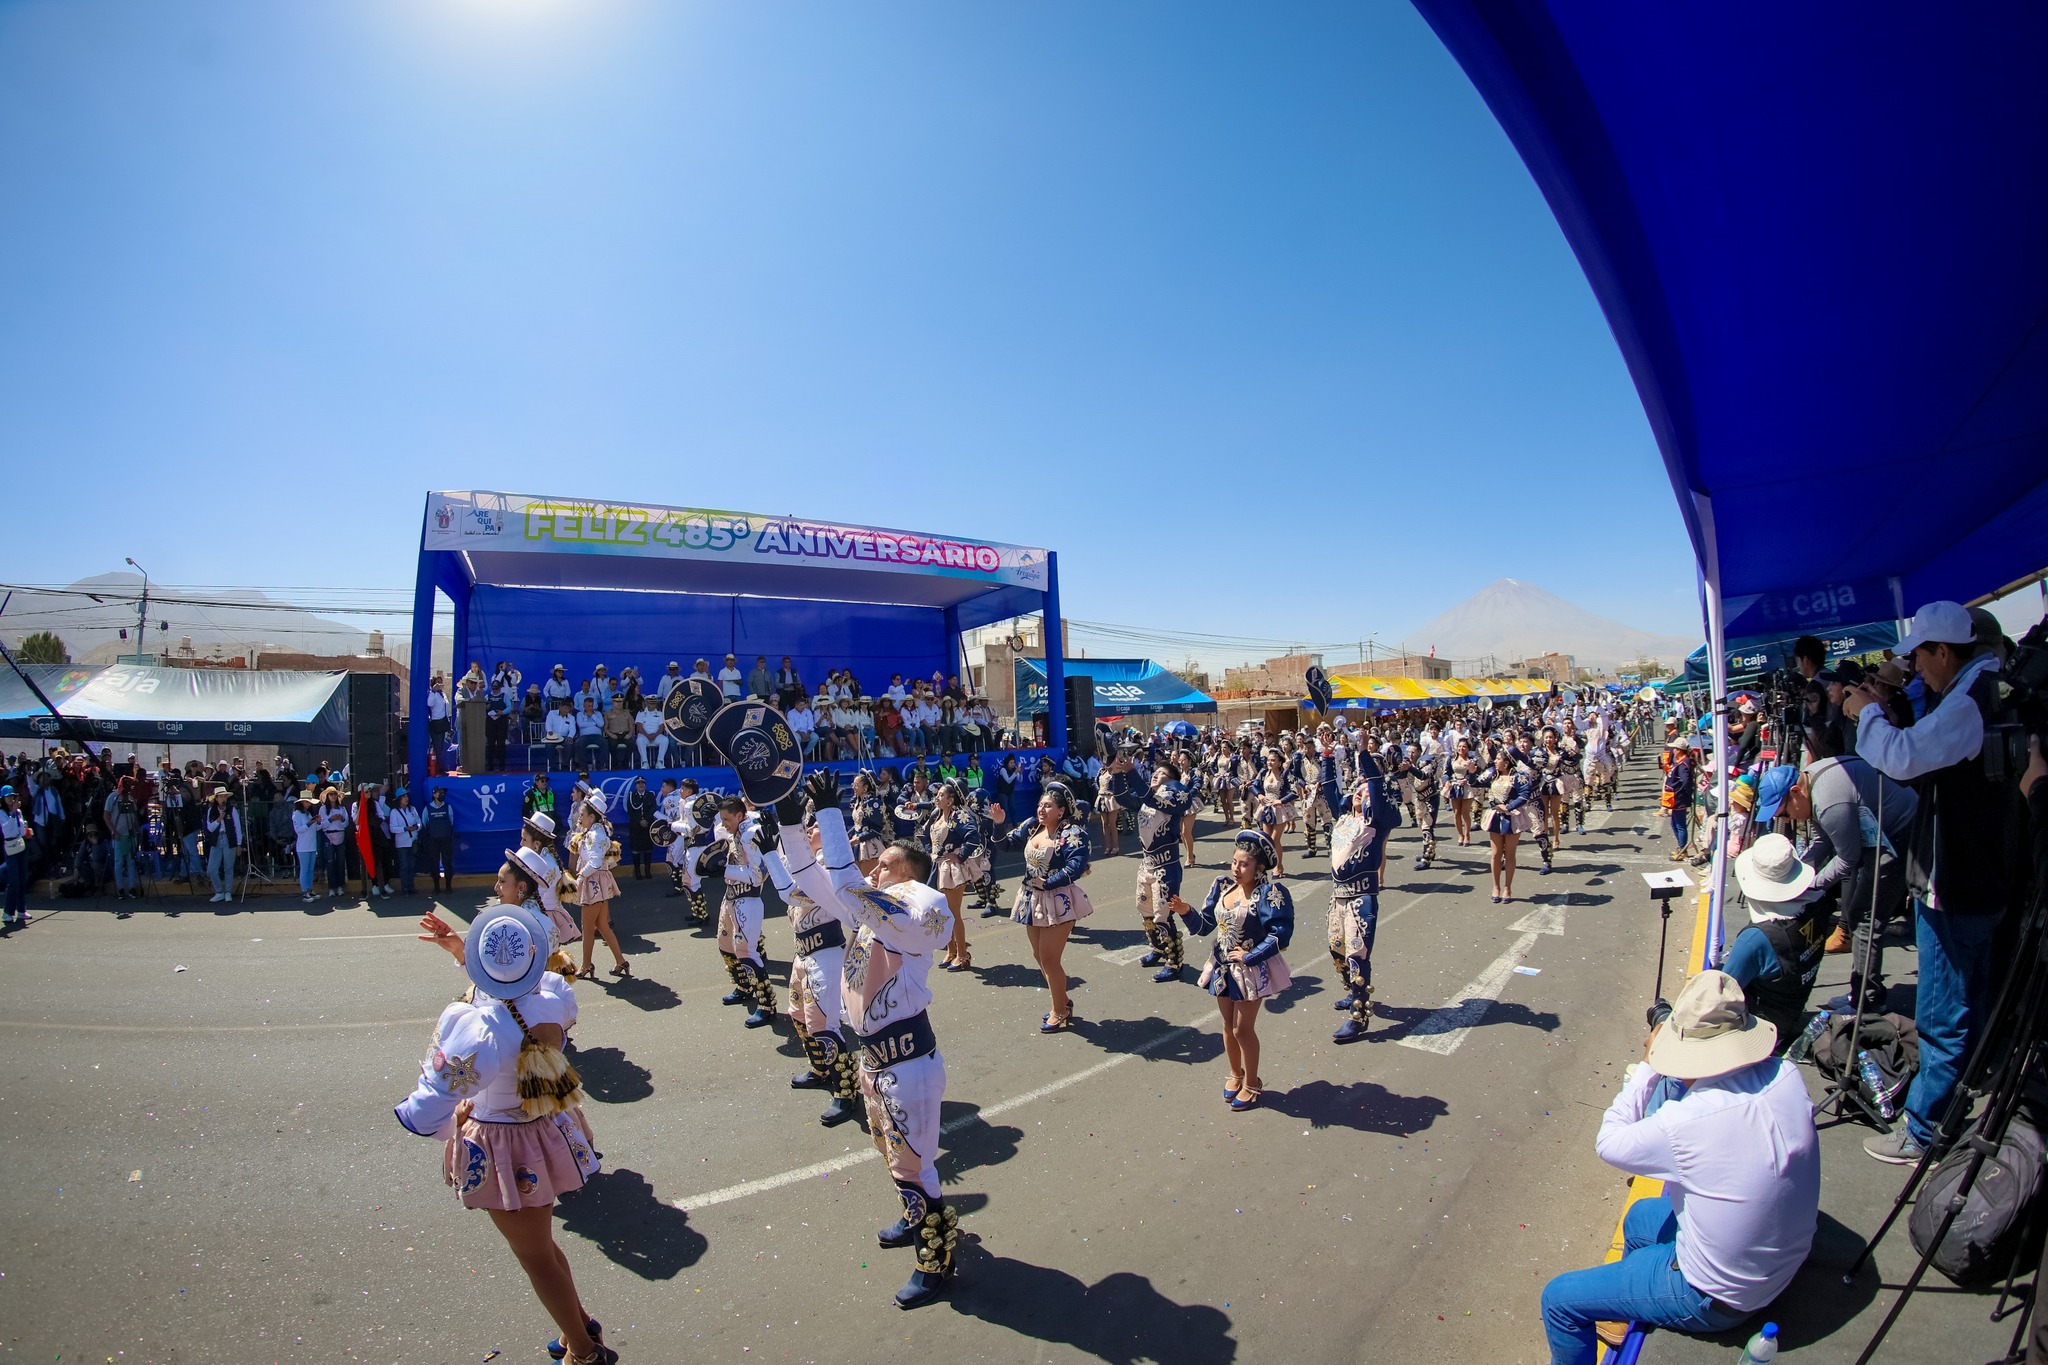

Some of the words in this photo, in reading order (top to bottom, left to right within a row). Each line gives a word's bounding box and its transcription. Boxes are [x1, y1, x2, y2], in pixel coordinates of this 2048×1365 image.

[477, 517, 492, 525] QUI
[485, 524, 495, 532] PA
[526, 504, 648, 545] FELIZ
[754, 520, 1001, 573] ANIVERSARIO
[1793, 584, 1857, 616] caja
[1831, 637, 1856, 650] caja
[1743, 653, 1768, 666] caja
[1095, 683, 1146, 698] caja
[39, 720, 60, 732] caja
[101, 720, 119, 731] caja
[165, 721, 184, 733] caja
[232, 722, 252, 733] caja
